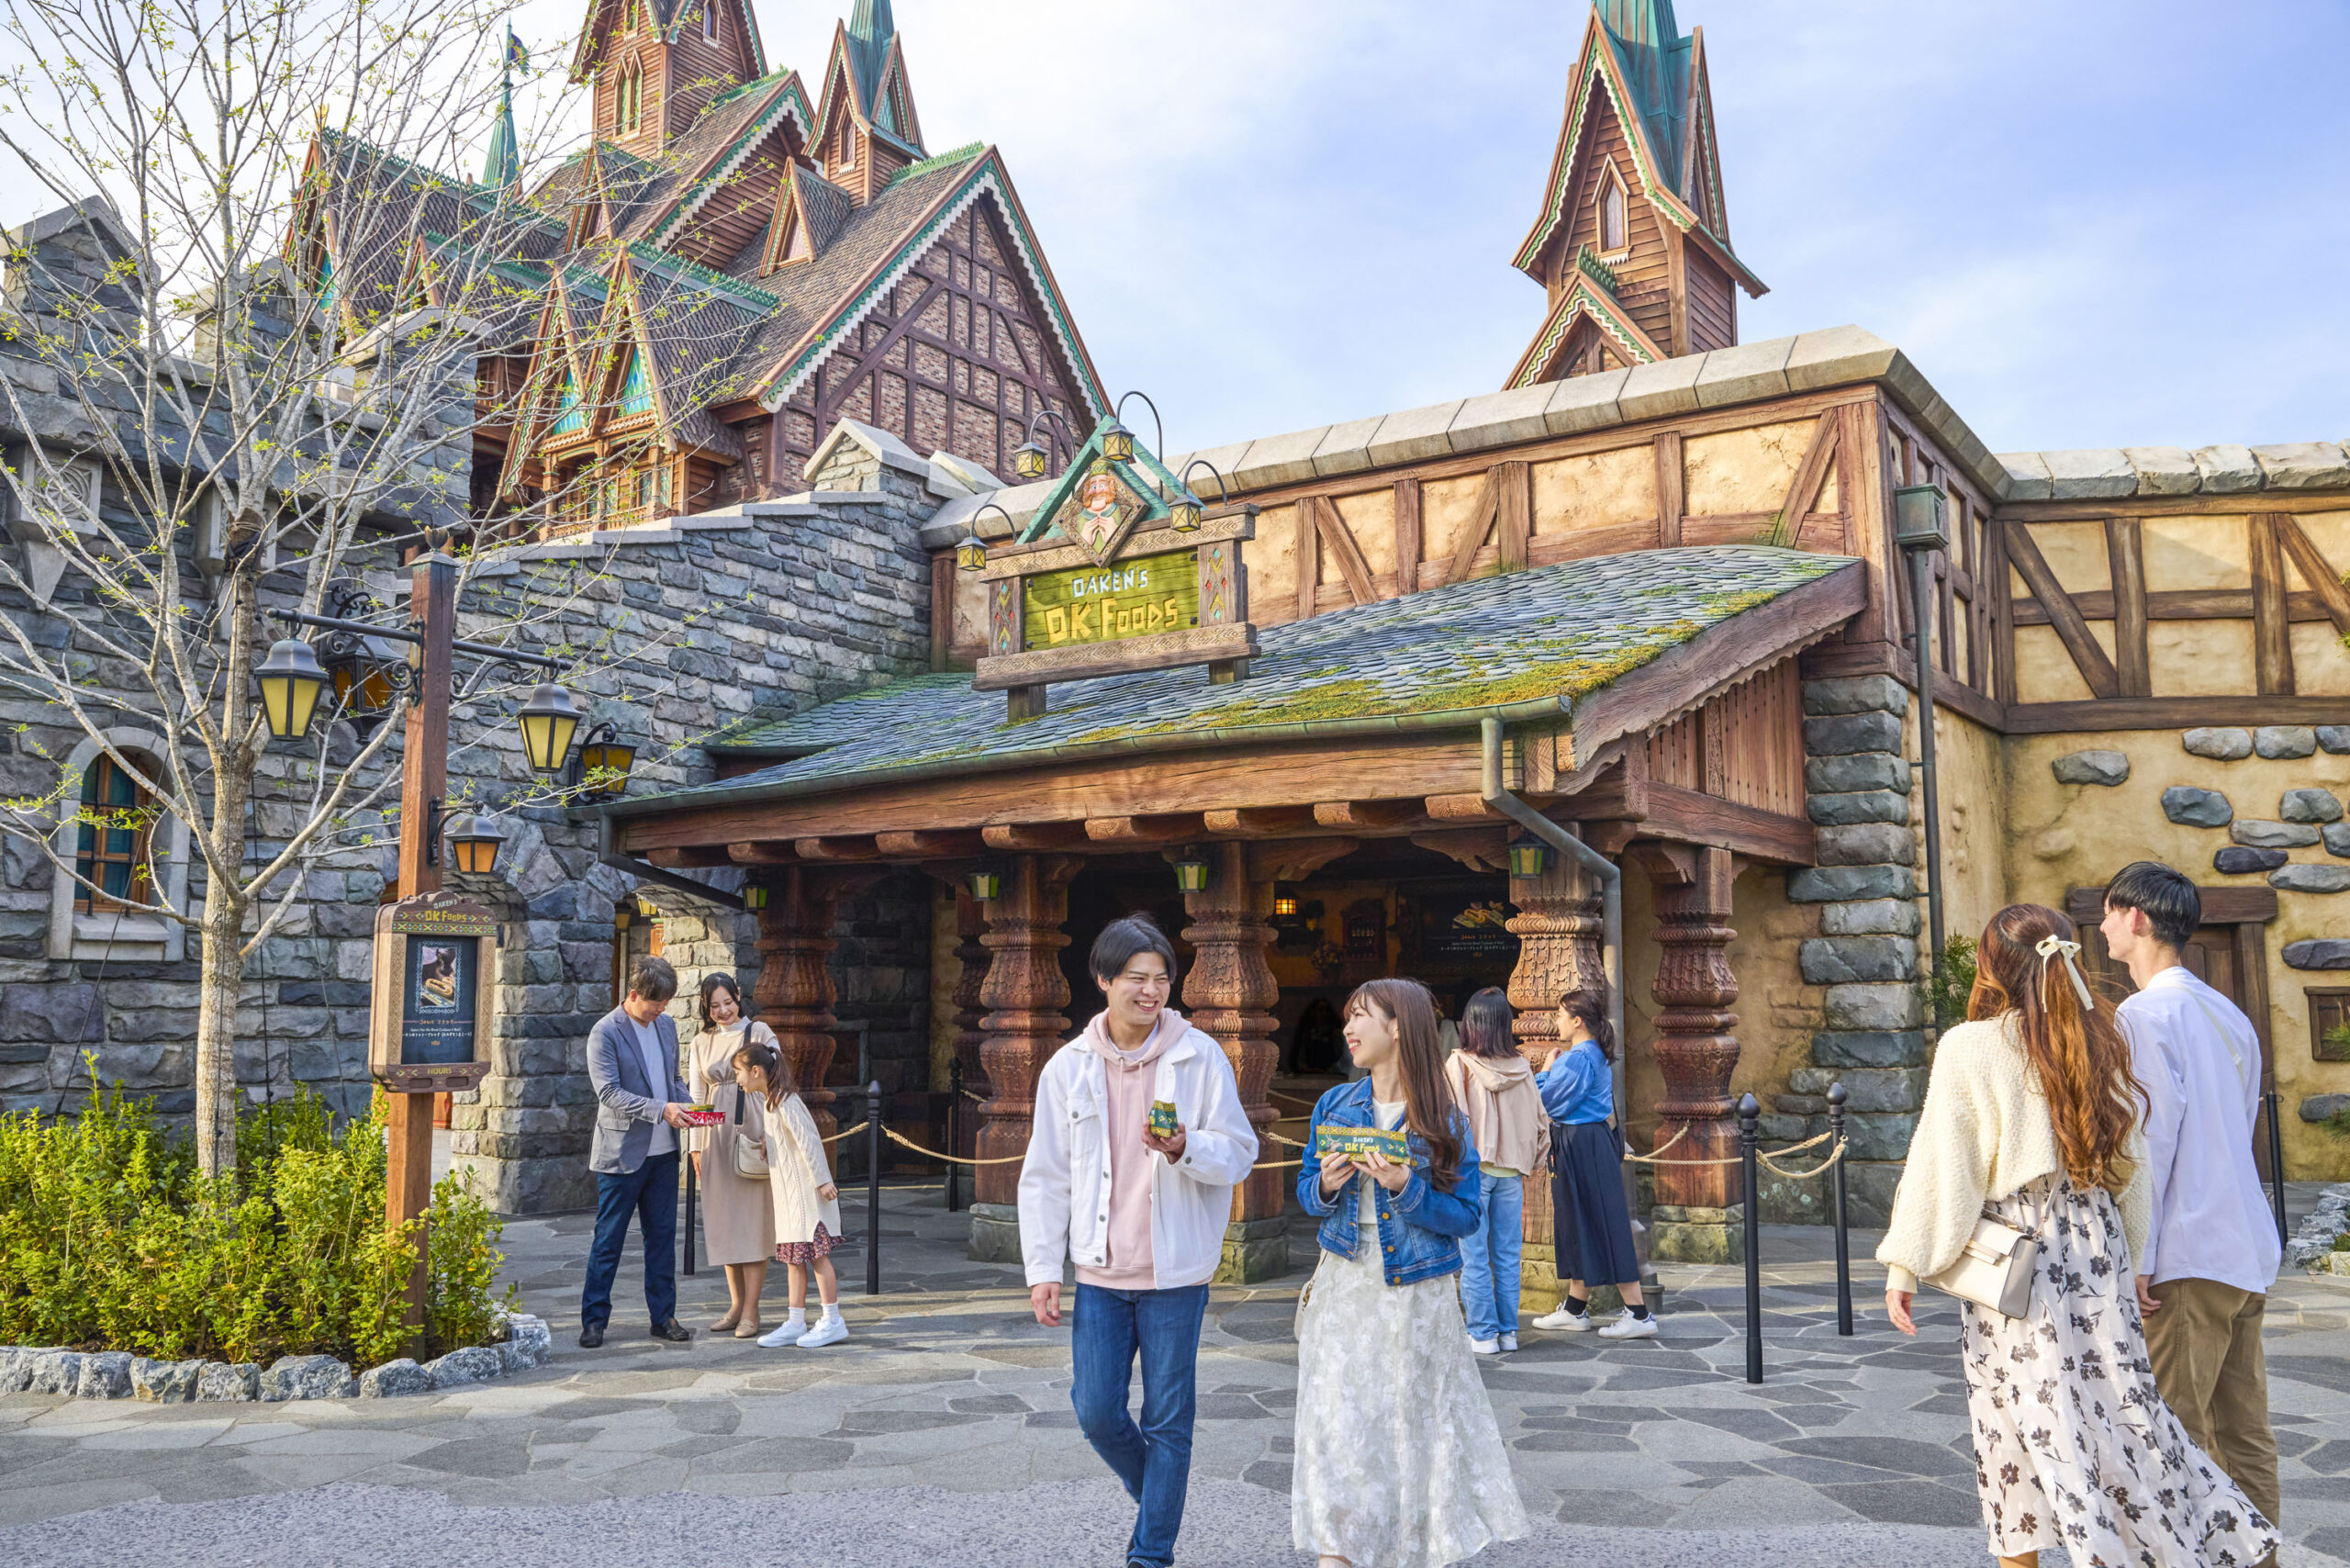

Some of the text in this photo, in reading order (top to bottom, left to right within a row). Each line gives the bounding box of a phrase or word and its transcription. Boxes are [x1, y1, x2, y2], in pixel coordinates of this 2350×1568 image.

[1072, 566, 1148, 599] OAKEN'S
[1044, 601, 1091, 644] OK
[425, 911, 441, 921] OK
[427, 1067, 453, 1075] HOURS
[1345, 1143, 1359, 1152] OK
